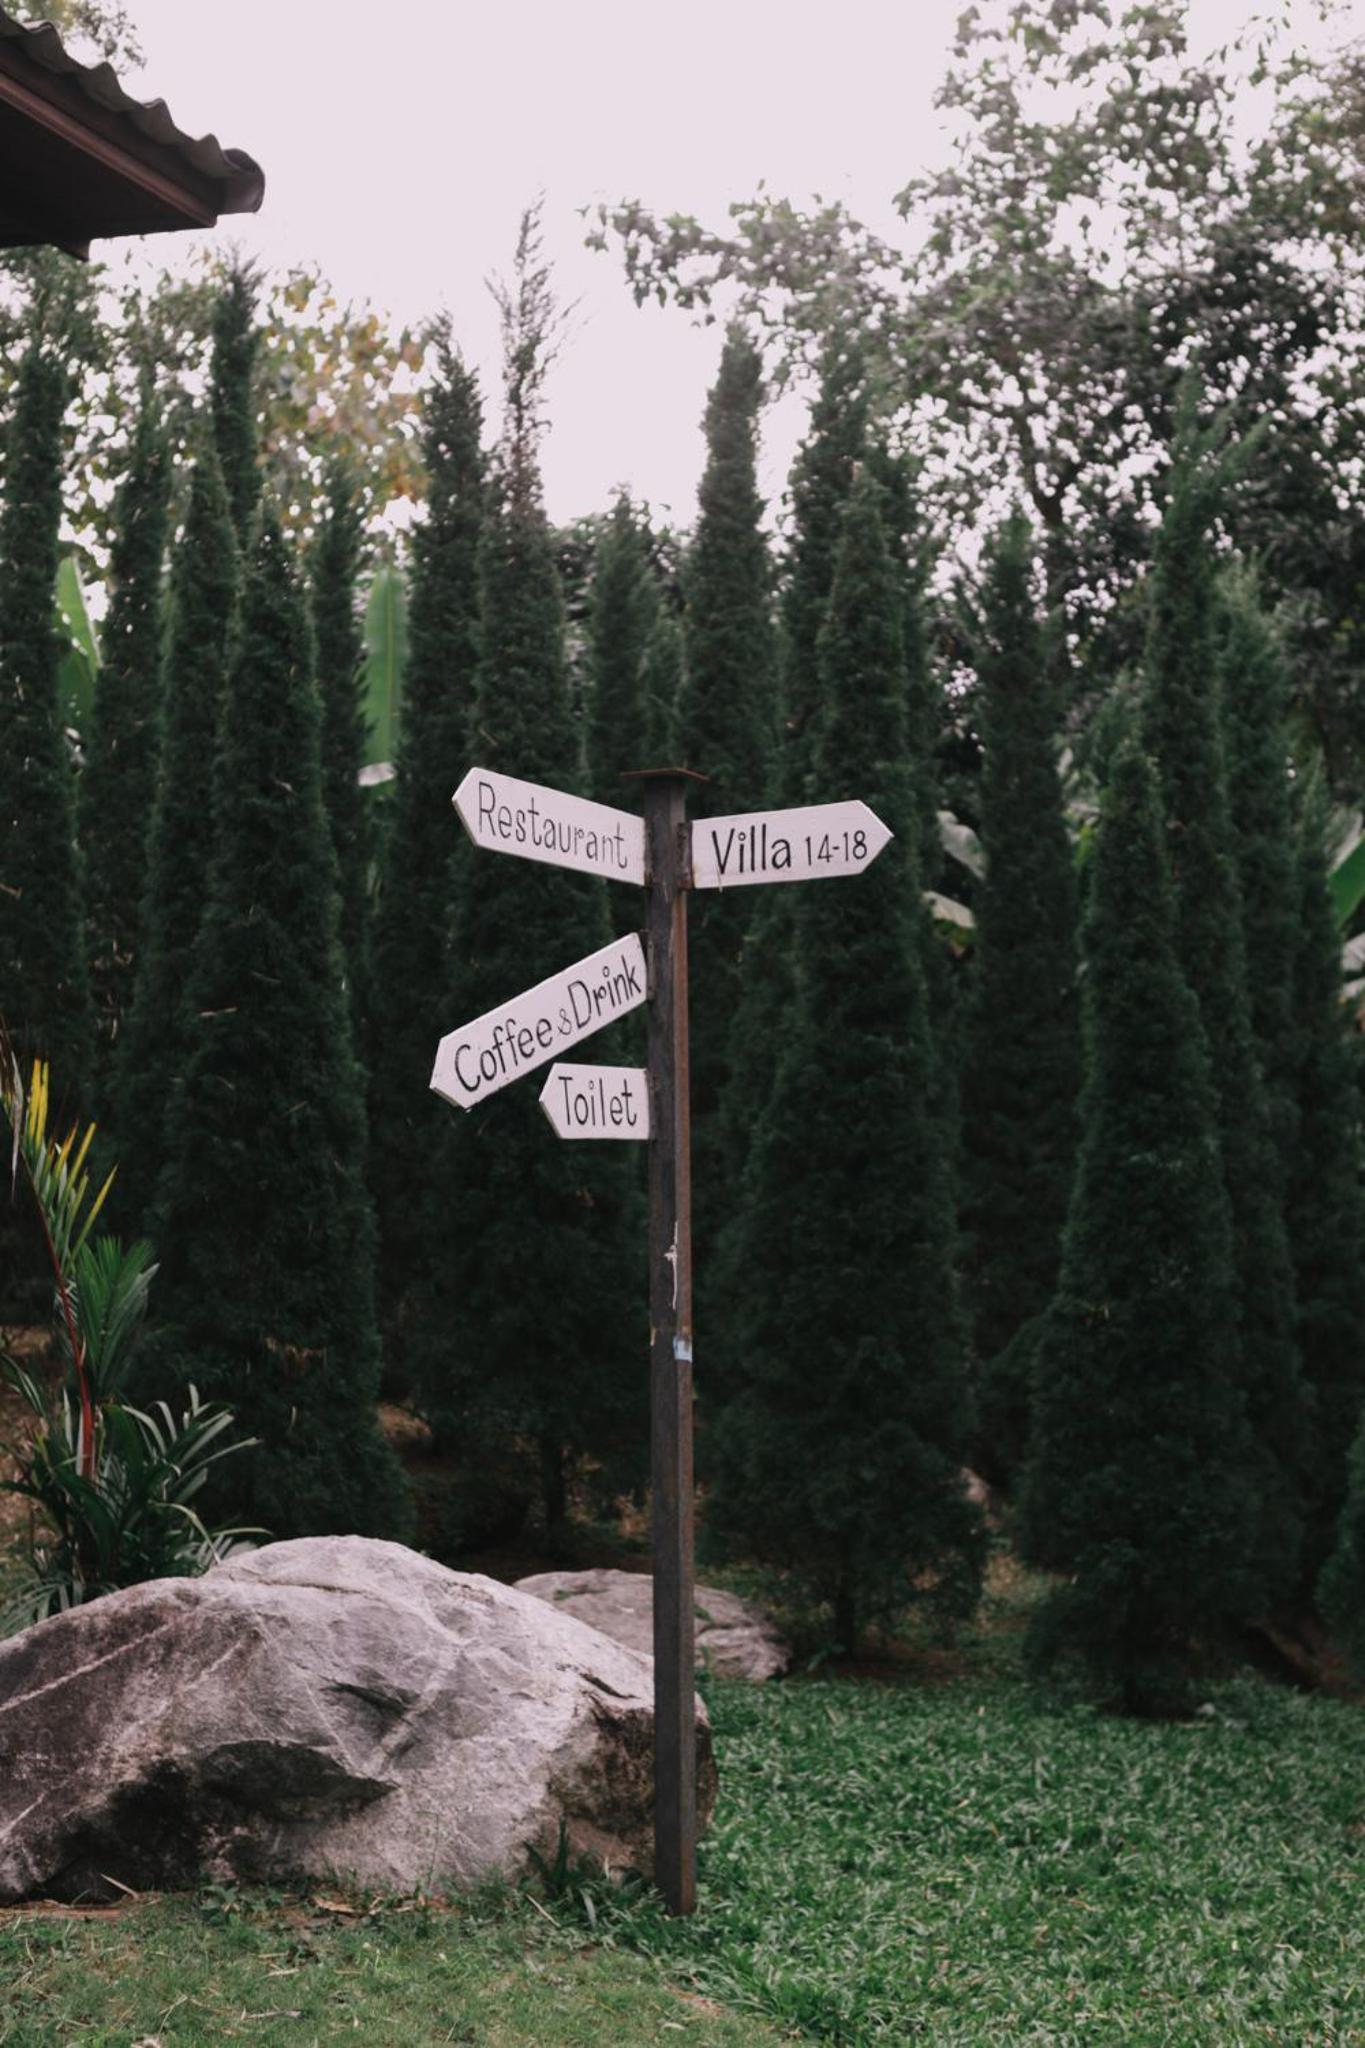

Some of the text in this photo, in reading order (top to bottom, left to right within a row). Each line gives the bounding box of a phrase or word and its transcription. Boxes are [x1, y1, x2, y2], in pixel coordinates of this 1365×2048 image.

[478, 781, 628, 869] Restaurant
[711, 823, 868, 875] Villa 14-18
[454, 1018, 553, 1092] Coffee
[567, 955, 641, 1029] Drink
[558, 1076, 638, 1127] Toilet
